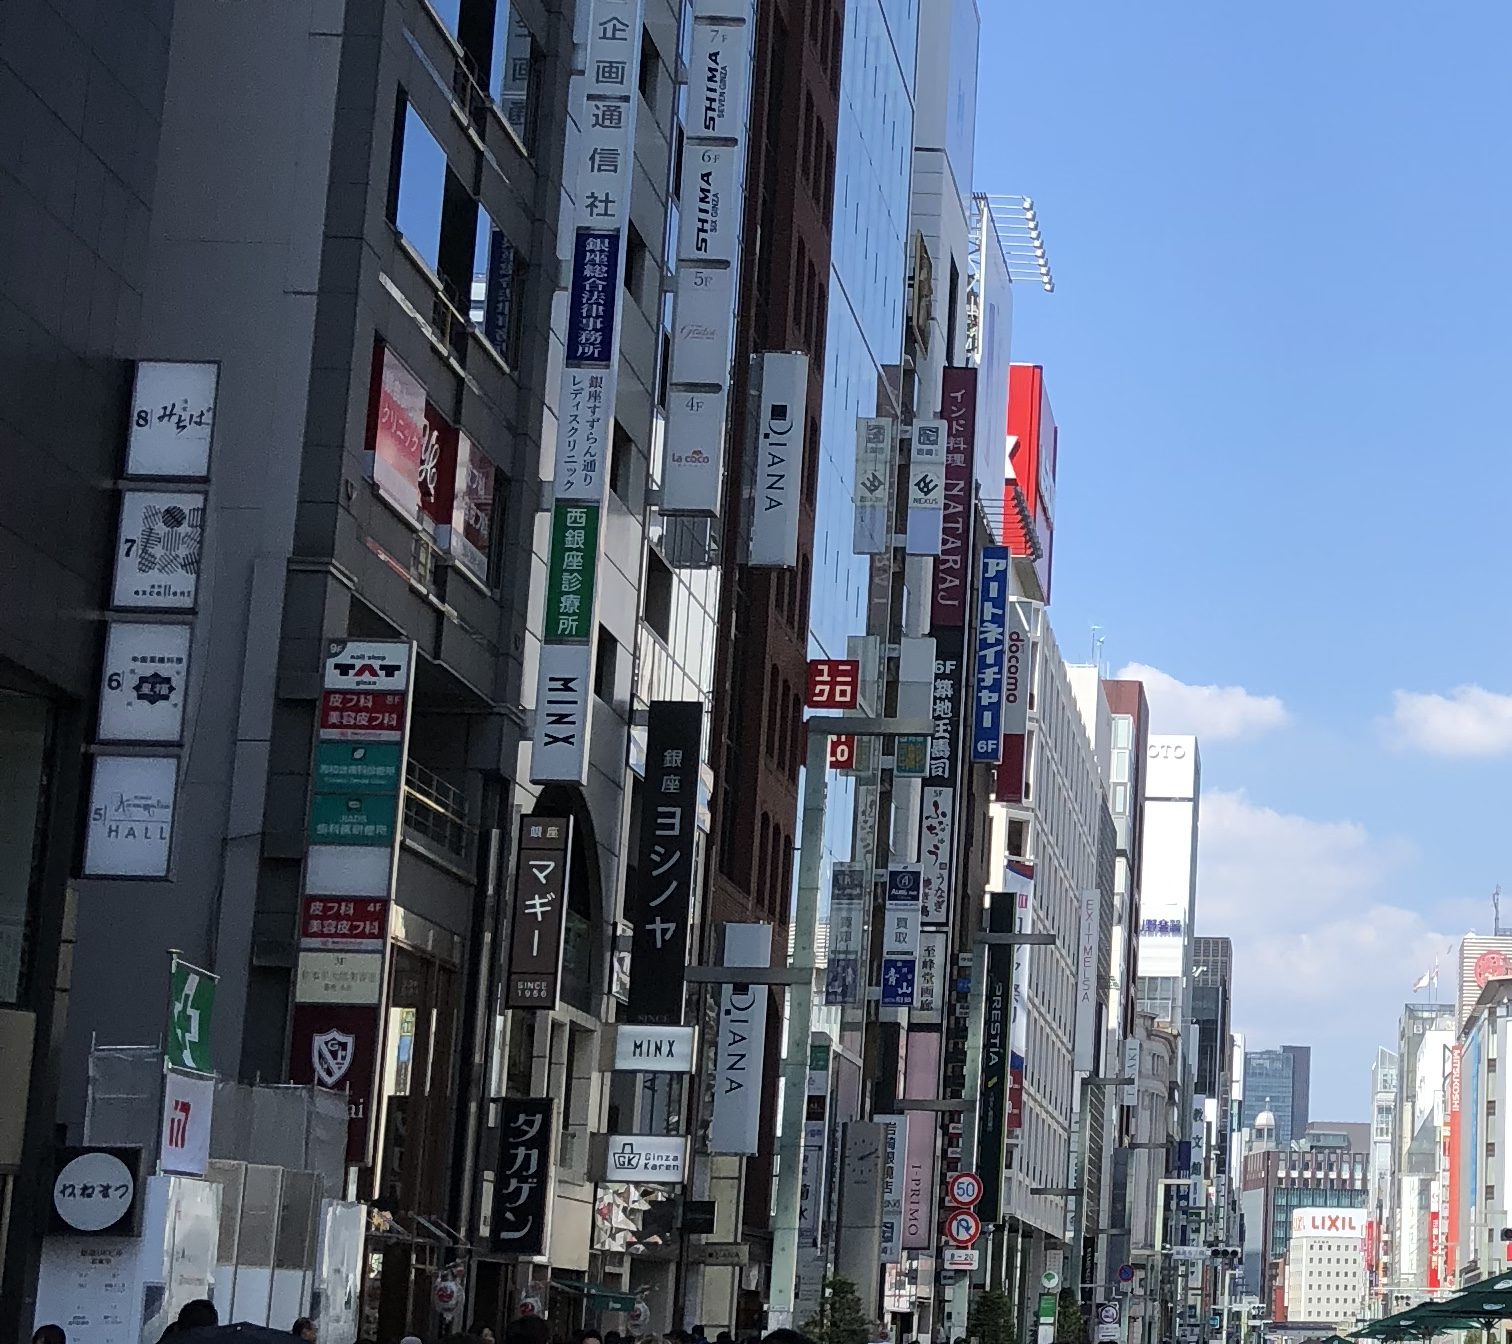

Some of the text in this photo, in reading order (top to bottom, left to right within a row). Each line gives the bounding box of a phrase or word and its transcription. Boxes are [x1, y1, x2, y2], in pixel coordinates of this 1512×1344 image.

[710, 30, 728, 43] 7F
[704, 50, 720, 131] SHIMA
[586, 17, 629, 217] 企画通信社
[701, 150, 720, 163] 6F
[696, 171, 712, 253] SHIMA
[694, 272, 713, 286] 5F
[577, 237, 610, 358] 銀座総合法律事務所
[685, 397, 704, 412] 4F
[136, 410, 149, 427] 8
[564, 375, 584, 491] レディスクリニック
[582, 375, 603, 486] 銀座すずらん通り
[764, 405, 793, 512] DIANA
[937, 389, 967, 606] インド料理 NATARAJ
[124, 539, 136, 557] 7
[558, 508, 587, 635] 西銀座診療所
[978, 558, 1007, 728] アートネイチャー
[935, 660, 956, 674] 6F
[1006, 631, 1025, 704] docomo
[107, 672, 122, 691] 6
[329, 695, 373, 708] 皮フ科
[328, 711, 397, 727] 美容皮フ科
[543, 677, 580, 747] MINX
[977, 741, 997, 752] 6F
[107, 824, 168, 841] HALL
[530, 826, 559, 838] 銀座
[310, 902, 354, 916] 皮フ科
[524, 860, 556, 956] マギー
[308, 920, 379, 935] 美容皮フ科
[518, 981, 547, 989] SINCE
[632, 1040, 675, 1058] MINX
[1452, 1049, 1461, 1112] MITSUKOSHI
[617, 1156, 635, 1167] GK
[500, 1113, 544, 1239] タカゲン
[956, 1182, 974, 1197] 50
[908, 1164, 922, 1236] I-PRIMO
[1311, 1215, 1357, 1231] LIXIL
